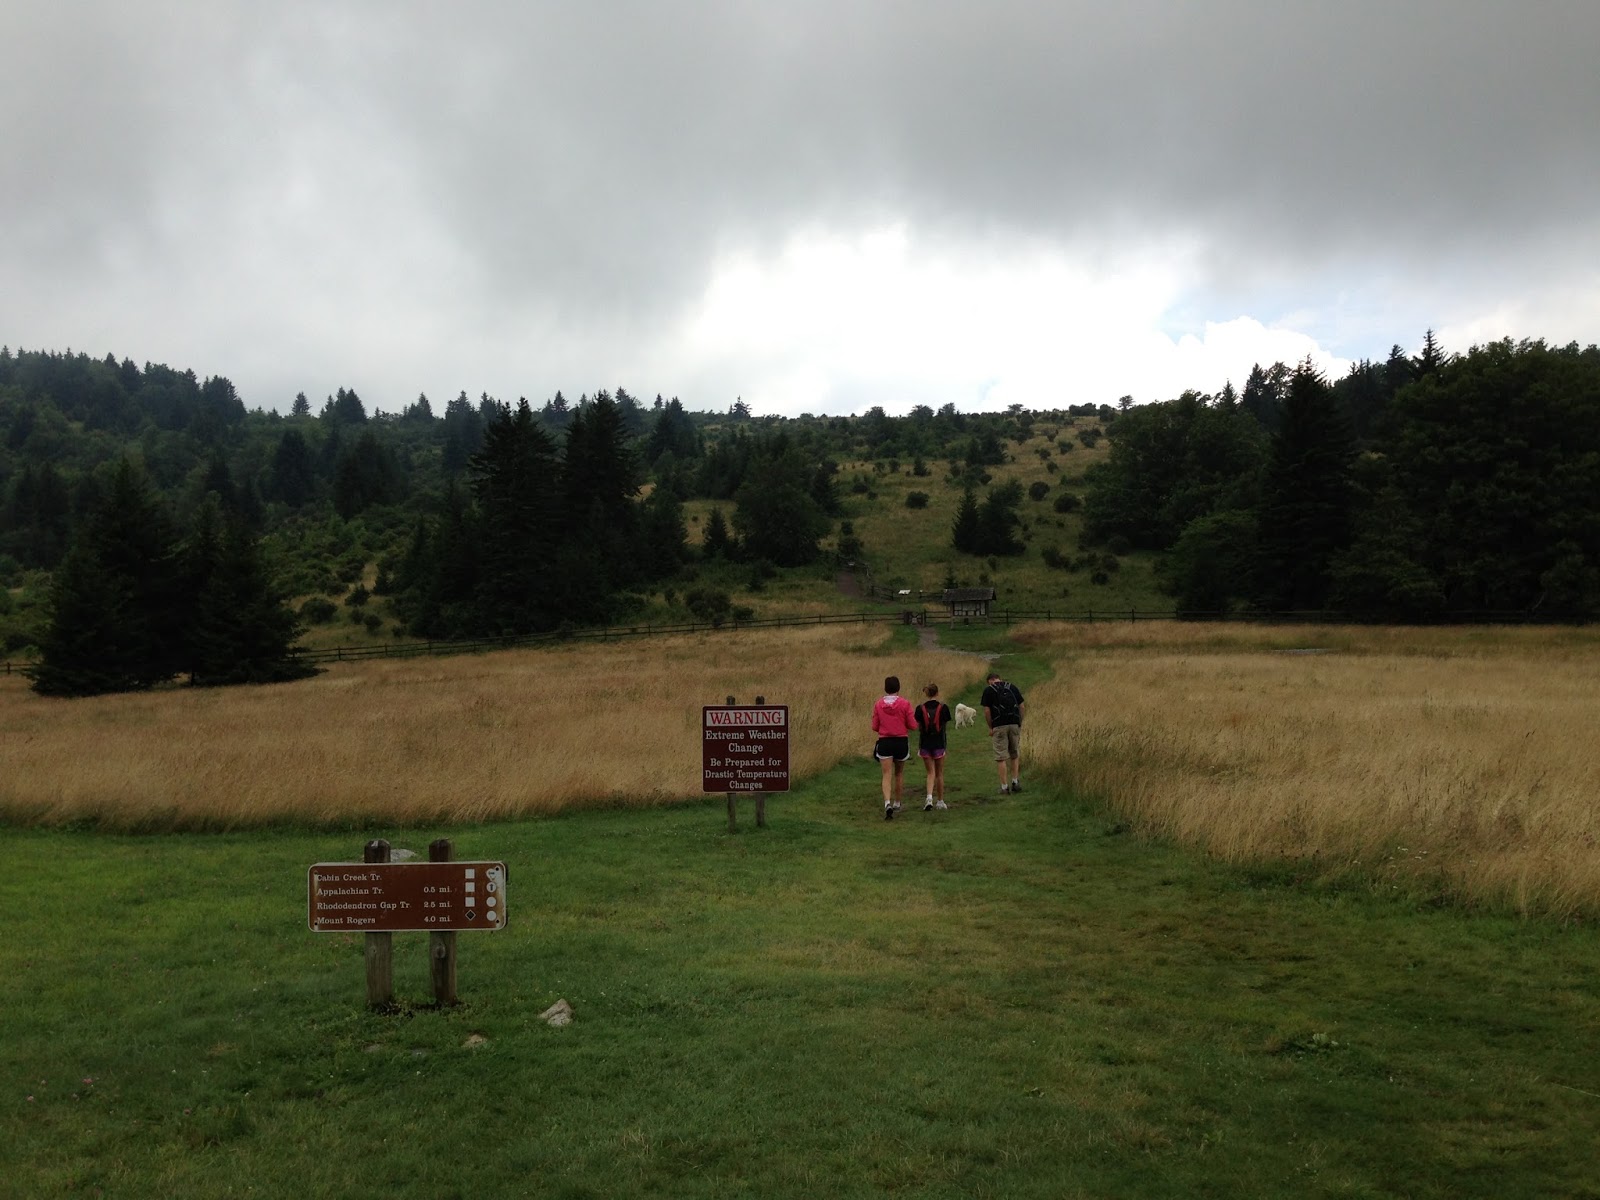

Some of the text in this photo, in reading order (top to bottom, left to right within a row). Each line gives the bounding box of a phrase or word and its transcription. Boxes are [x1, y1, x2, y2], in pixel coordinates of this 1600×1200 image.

[710, 712, 782, 724] WARNING
[705, 730, 786, 739] Extreme Weather
[729, 743, 763, 754] Change
[710, 758, 721, 766] Be
[725, 758, 764, 768] Prepared
[705, 770, 787, 780] Drastic Temperature
[729, 781, 763, 790] Changes
[317, 888, 369, 896] Appalachian
[380, 902, 397, 910] Gap
[347, 917, 376, 925] Rogers
